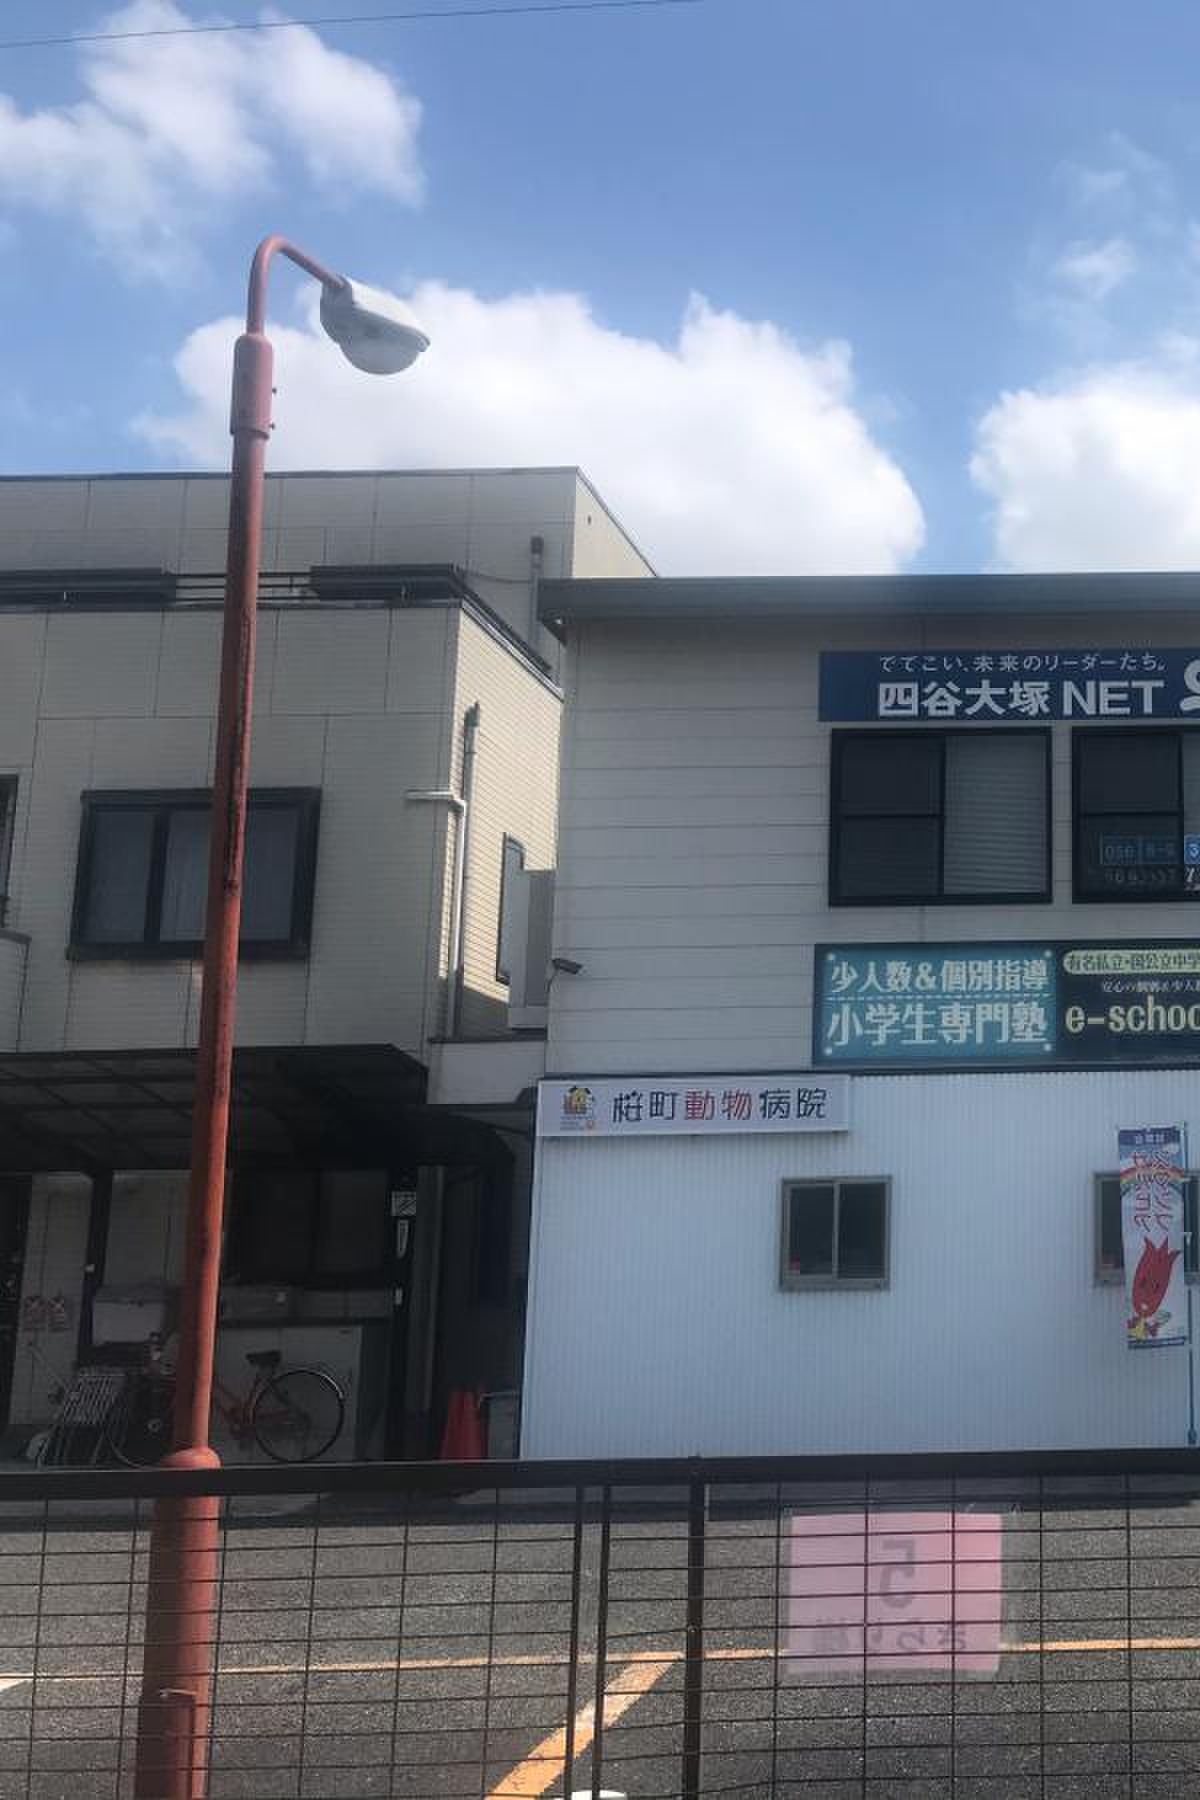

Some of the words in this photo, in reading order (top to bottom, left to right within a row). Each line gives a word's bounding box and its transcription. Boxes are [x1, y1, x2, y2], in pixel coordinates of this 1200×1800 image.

[878, 679, 1050, 717] 四谷大塚
[1063, 679, 1165, 715] NET
[827, 1001, 1049, 1046] 小学生専門塾
[613, 1087, 829, 1123] 桜町動物病院
